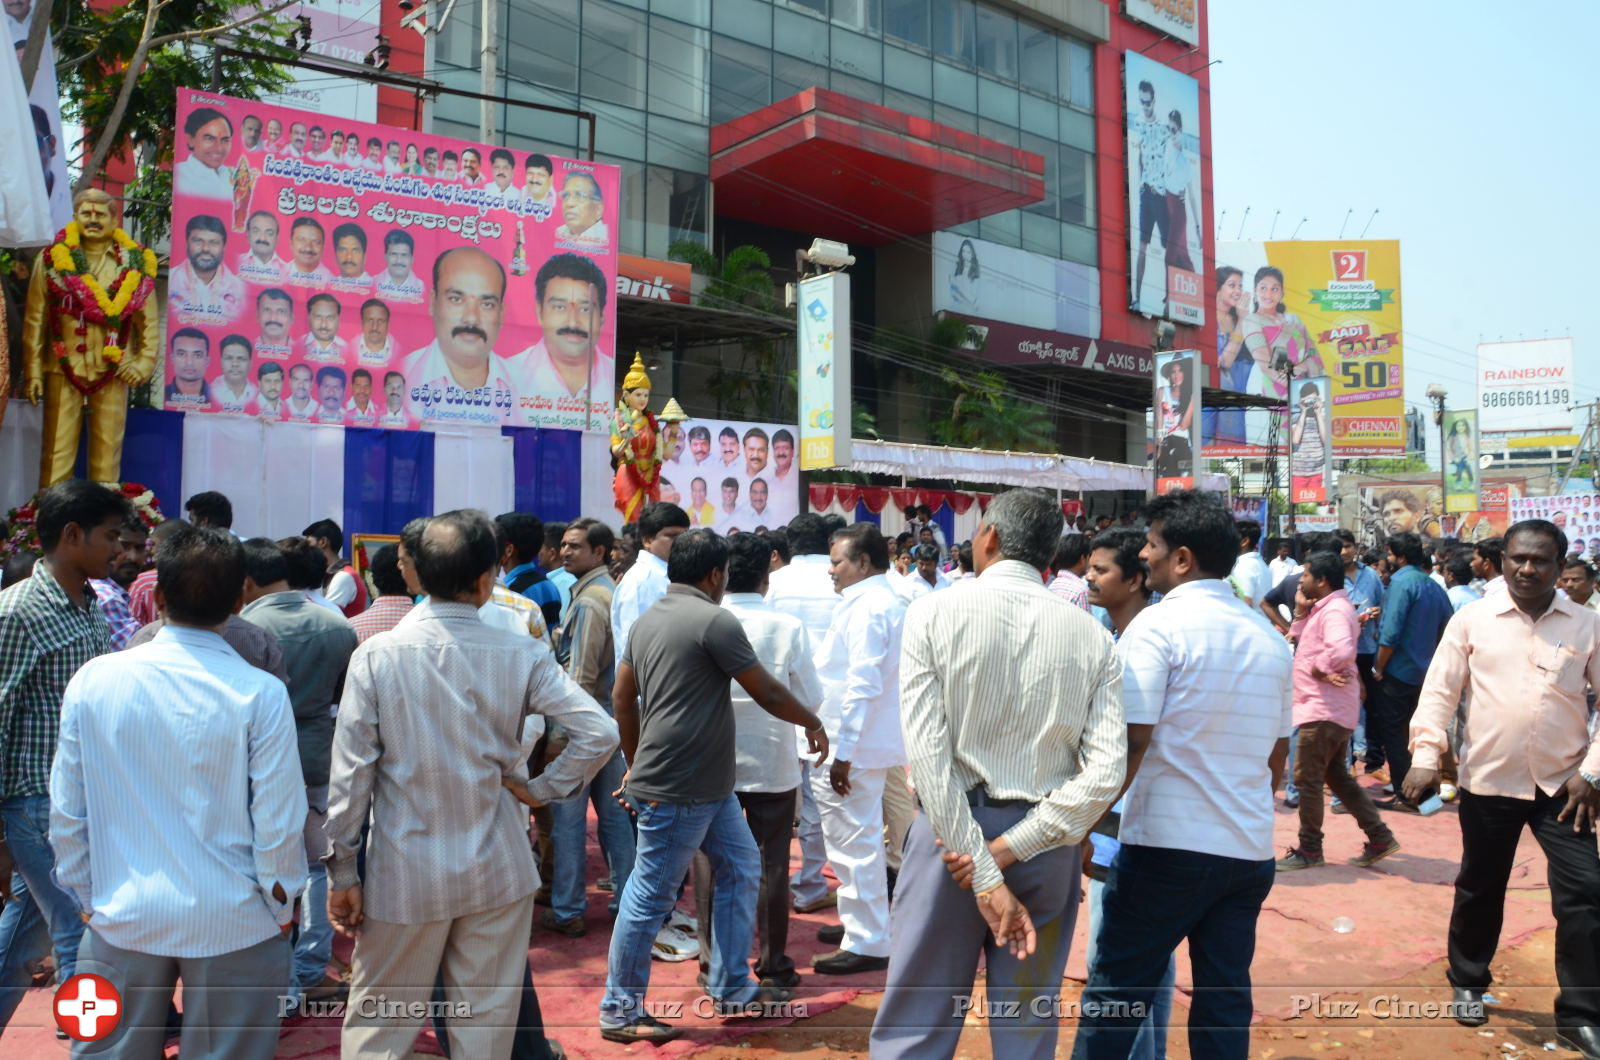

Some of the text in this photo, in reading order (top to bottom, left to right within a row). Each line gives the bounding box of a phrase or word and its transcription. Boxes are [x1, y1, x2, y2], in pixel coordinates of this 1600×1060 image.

[278, 187, 501, 244] ప్రజలకు శుభాకాంక్షలు
[1341, 255, 1359, 278] 2
[617, 276, 672, 300] ank
[1174, 273, 1197, 296] fbb
[1330, 326, 1363, 339] AADI
[1339, 338, 1388, 356] SALE
[1107, 352, 1136, 370] AXIS
[1342, 361, 1386, 388] 50
[1485, 367, 1565, 380] RAINBOW
[1482, 389, 1569, 407] 9866661199
[1349, 420, 1400, 431] CHENNAI
[807, 441, 829, 460] fbb
[1166, 479, 1184, 489] fbb
